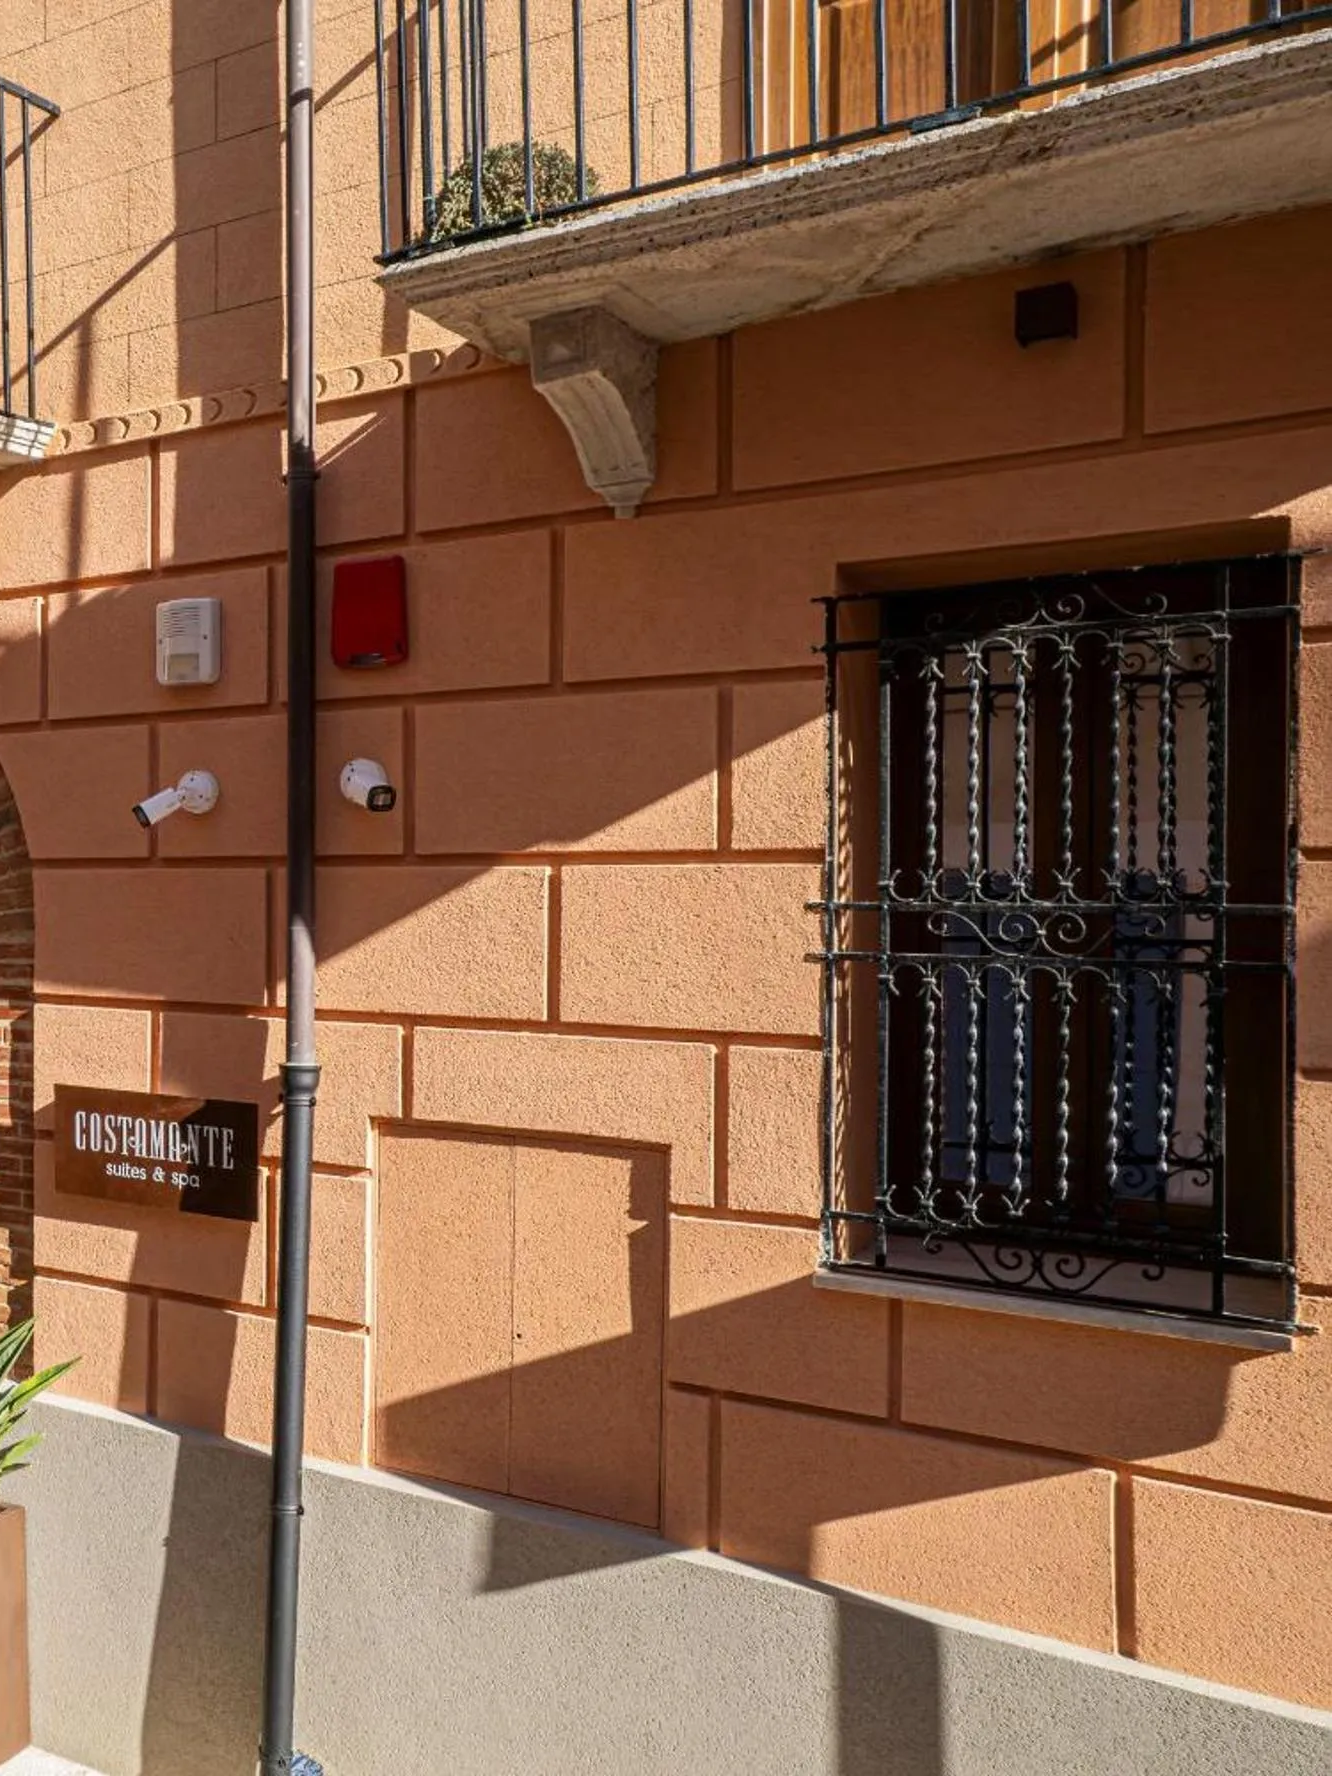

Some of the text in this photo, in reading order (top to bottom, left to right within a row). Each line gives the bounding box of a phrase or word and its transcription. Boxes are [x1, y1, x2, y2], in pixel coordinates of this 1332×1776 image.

[75, 1110, 234, 1169] COSTAMANTE
[105, 1162, 200, 1191] suites & spa
